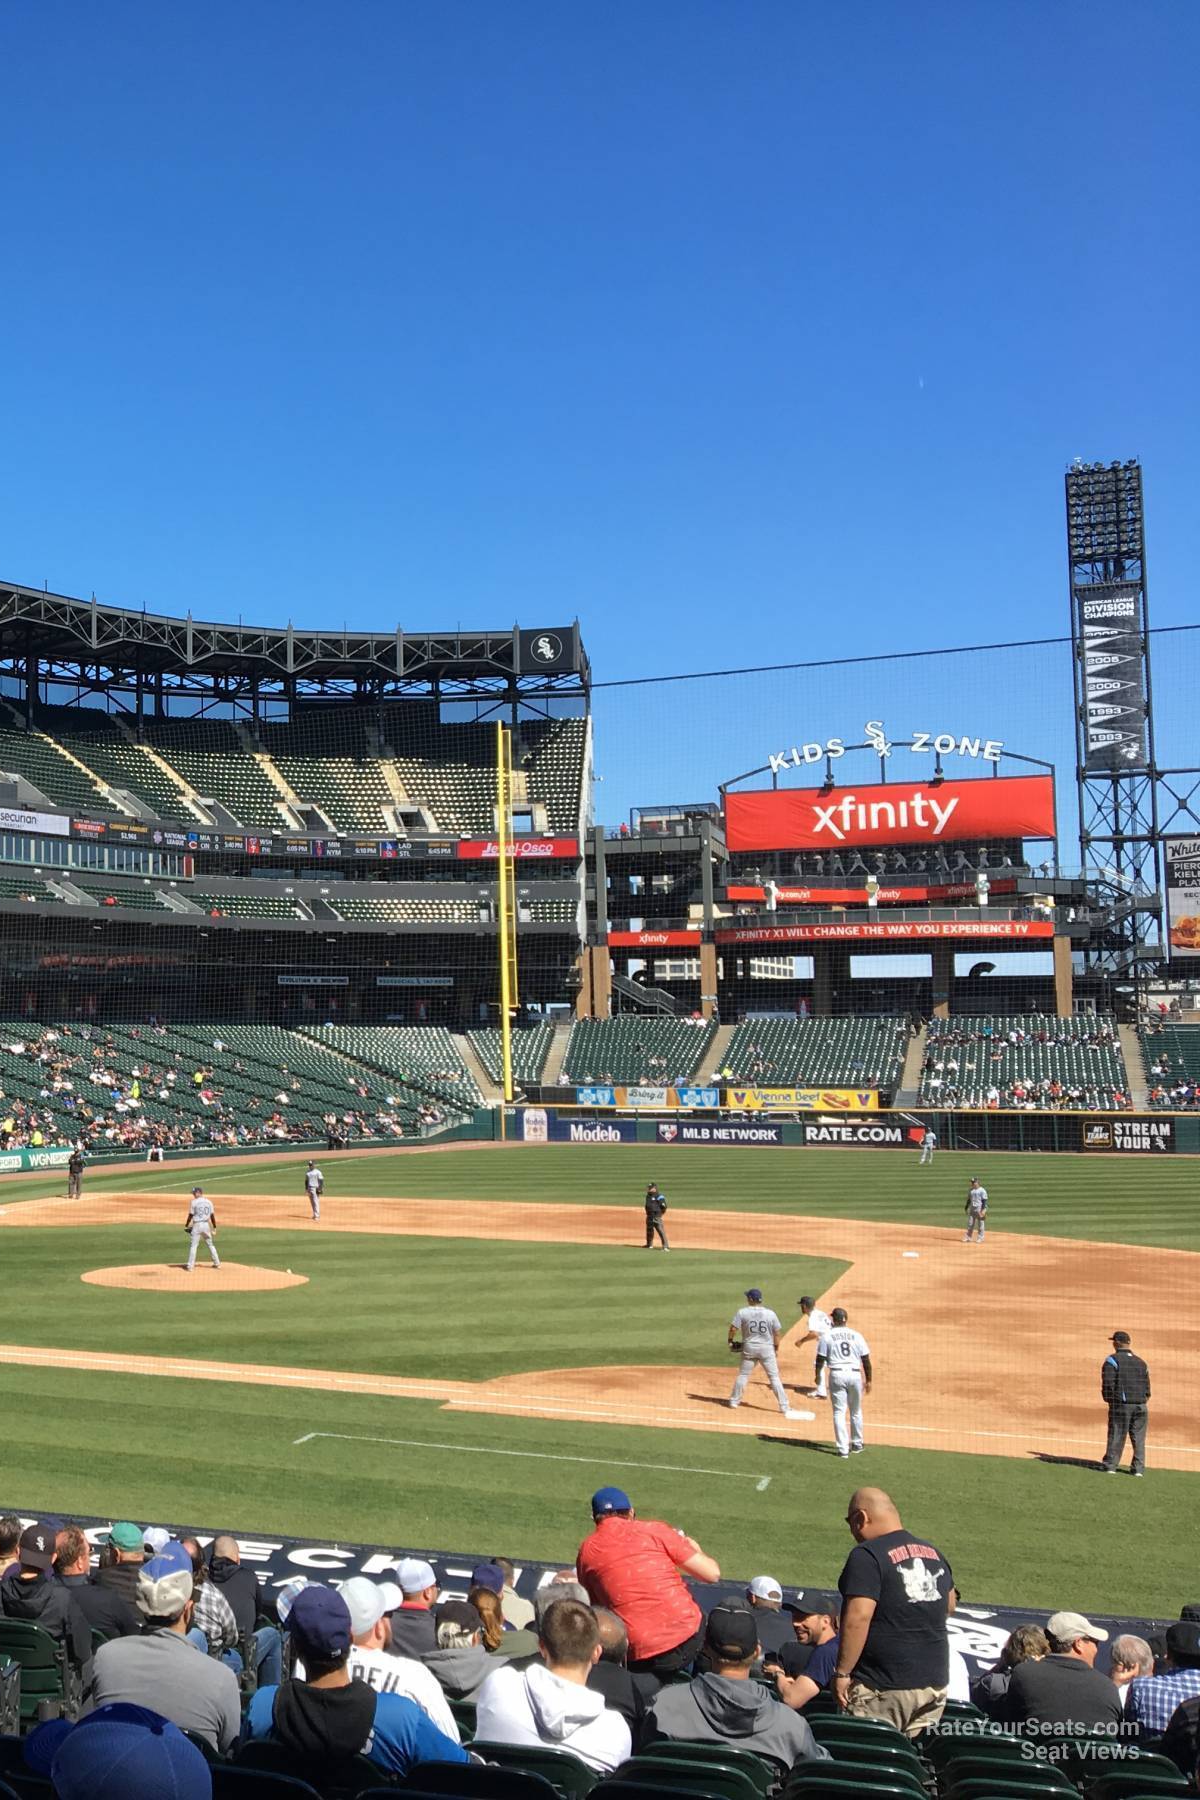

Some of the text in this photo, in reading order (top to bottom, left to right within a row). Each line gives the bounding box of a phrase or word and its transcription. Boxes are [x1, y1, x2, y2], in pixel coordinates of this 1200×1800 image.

[1084, 602, 1134, 614] DIVISION
[1084, 610, 1134, 620] CHAMPIONS
[1088, 682, 1121, 690] 2000
[768, 732, 1006, 774] KIDS ZONE
[0, 812, 37, 825] securian
[812, 792, 960, 840] xfinity
[482, 842, 554, 854] Jeel-Osco
[736, 924, 1028, 939] XFINITY X1 WILL CHANGE THE WAY YOU EXPERIENCE TV
[639, 934, 668, 944] xfinity
[629, 1089, 655, 1100] Bring
[753, 1090, 820, 1101] Vienna Beef
[570, 1124, 620, 1142] Modelo
[683, 1128, 777, 1141] MLB NETWORK
[805, 1126, 902, 1142] RATE.COM
[1114, 1123, 1170, 1136] STREAM
[1114, 1136, 1151, 1150] YOUR
[29, 1153, 53, 1166] WGN
[750, 1320, 768, 1334] 26
[840, 1342, 850, 1356] 8
